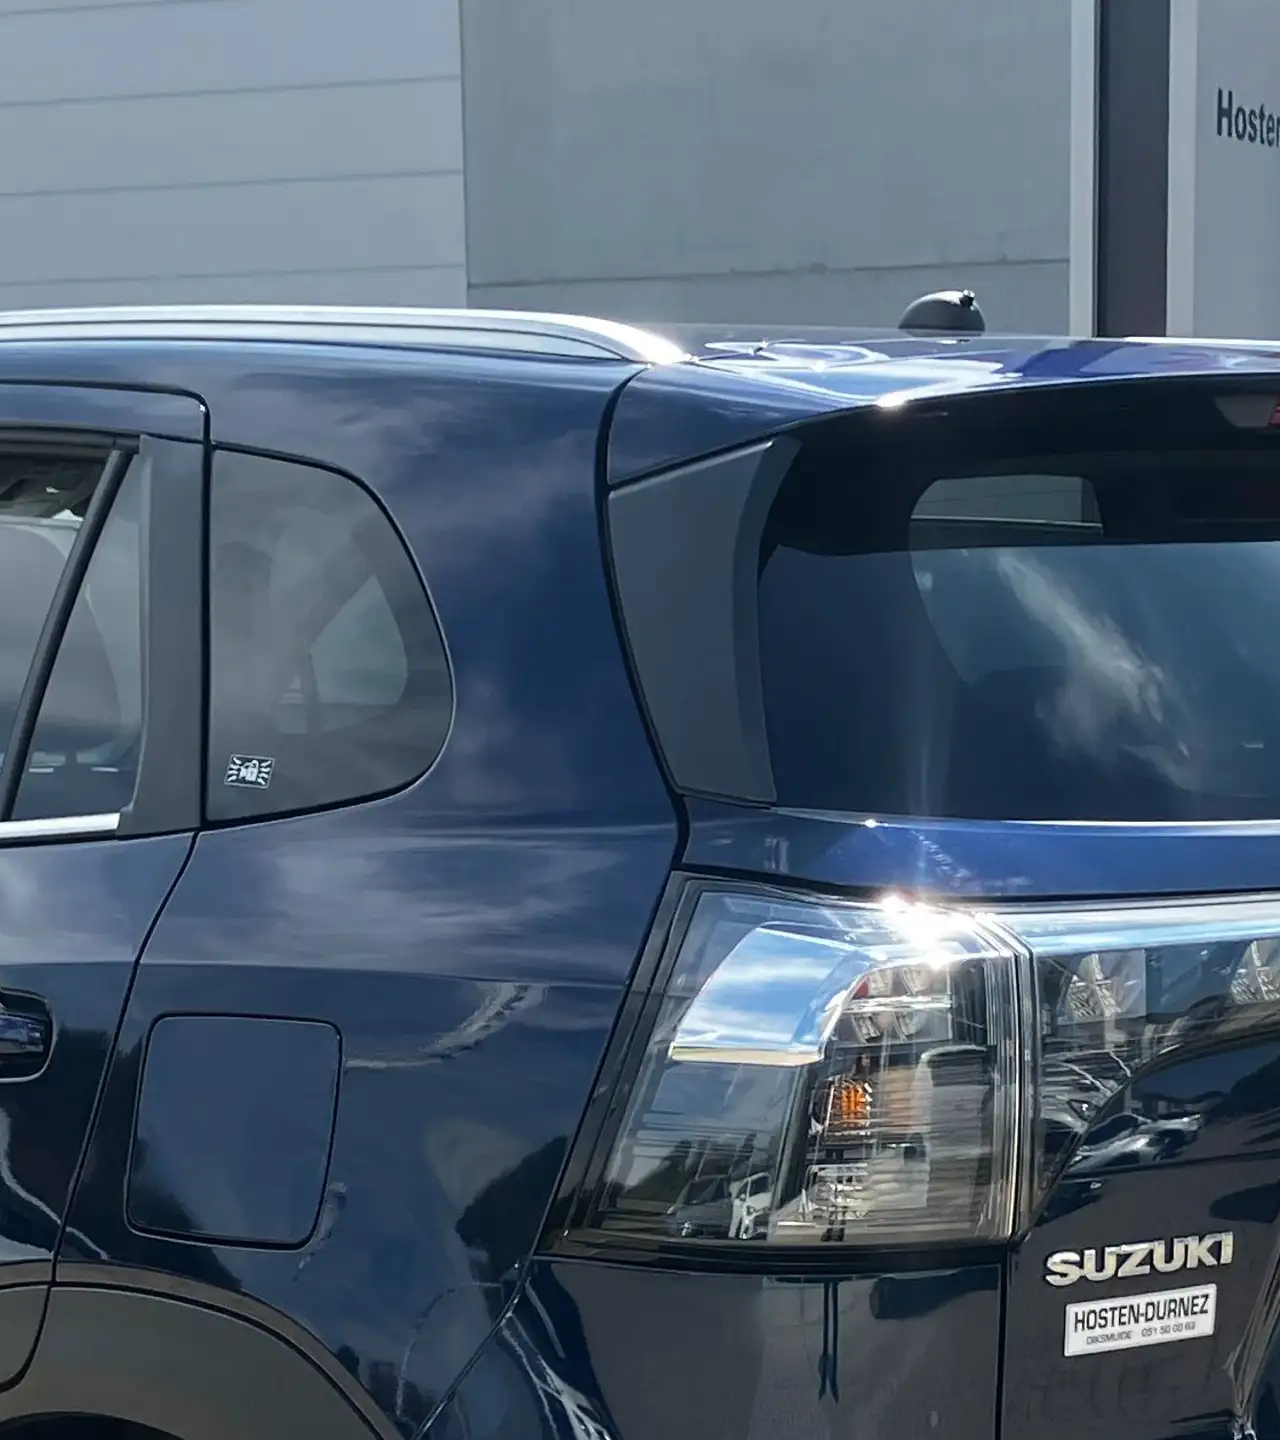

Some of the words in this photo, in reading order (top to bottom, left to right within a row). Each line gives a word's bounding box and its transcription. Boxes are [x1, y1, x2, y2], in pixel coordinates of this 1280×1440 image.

[1045, 1231, 1234, 1287] SUZUKI
[1073, 1293, 1210, 1334] HOSTEN-DURNEZ
[1141, 1325, 1158, 1338] 051
